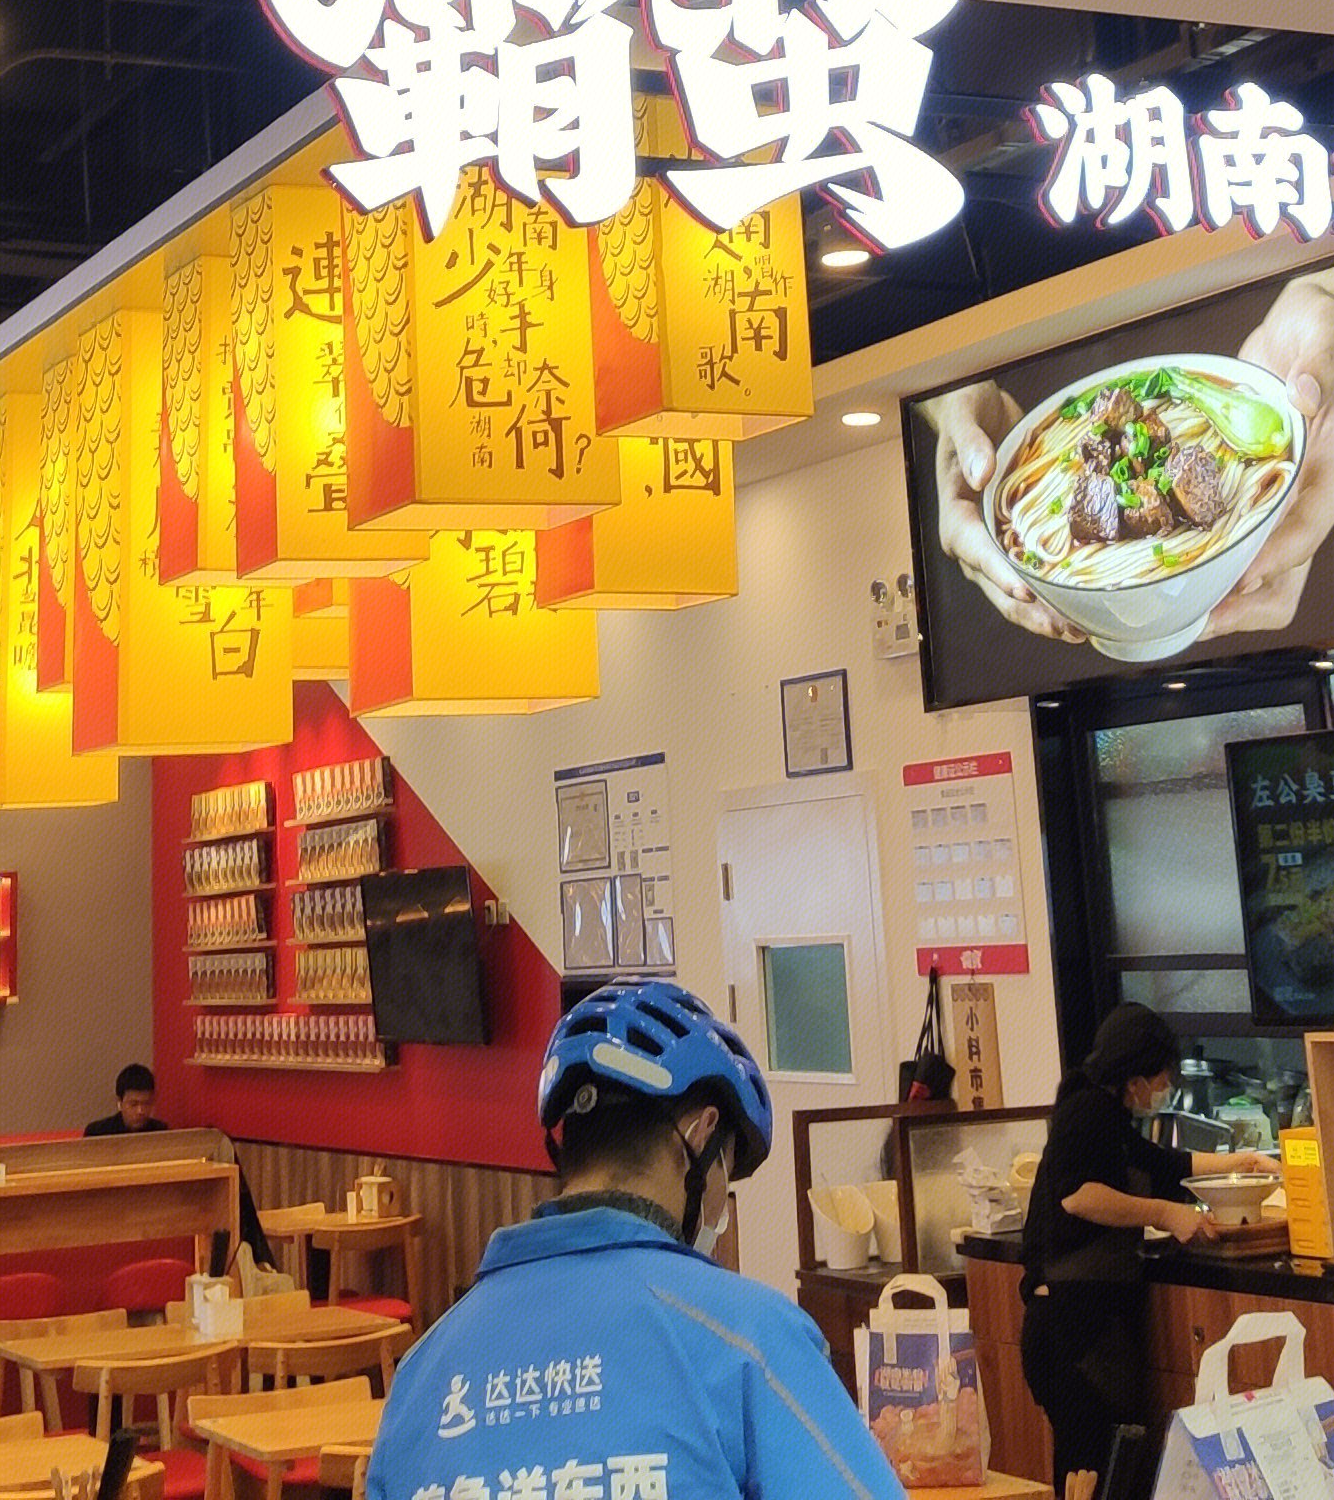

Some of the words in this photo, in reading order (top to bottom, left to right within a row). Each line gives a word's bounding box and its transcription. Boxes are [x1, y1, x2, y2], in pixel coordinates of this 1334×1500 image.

[485, 1353, 603, 1409] 达达快送
[412, 1453, 668, 1500] 送东西
